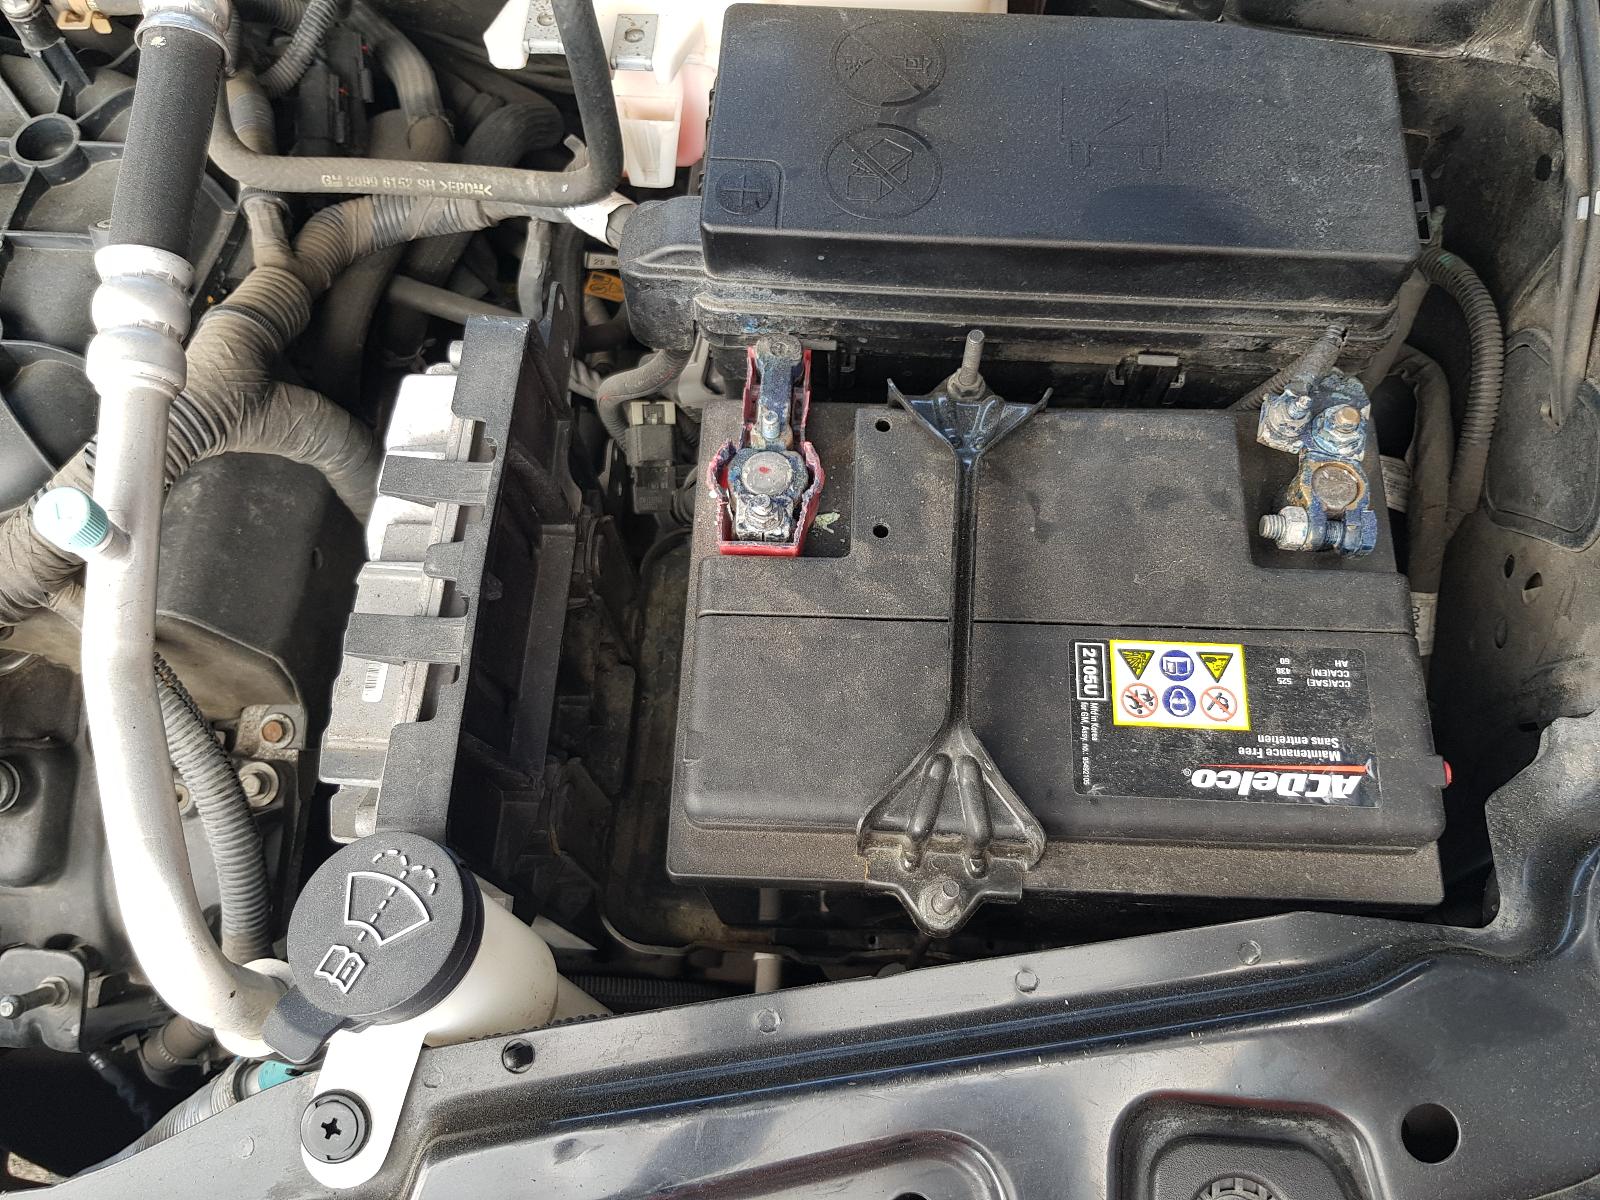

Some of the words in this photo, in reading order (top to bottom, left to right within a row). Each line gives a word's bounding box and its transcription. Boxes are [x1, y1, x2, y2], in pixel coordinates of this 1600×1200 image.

[1082, 647, 1099, 695] 2105U
[1312, 668, 1350, 677] CCA(EN)
[1307, 678, 1351, 688] CCA(SAE)
[1080, 701, 1089, 712] for
[1080, 711, 1089, 725] GM,
[1091, 724, 1100, 741] Korea
[1257, 735, 1309, 746] entretien
[1311, 736, 1339, 748] Sans
[1238, 746, 1264, 758] Free
[1266, 749, 1341, 762] Maintenance
